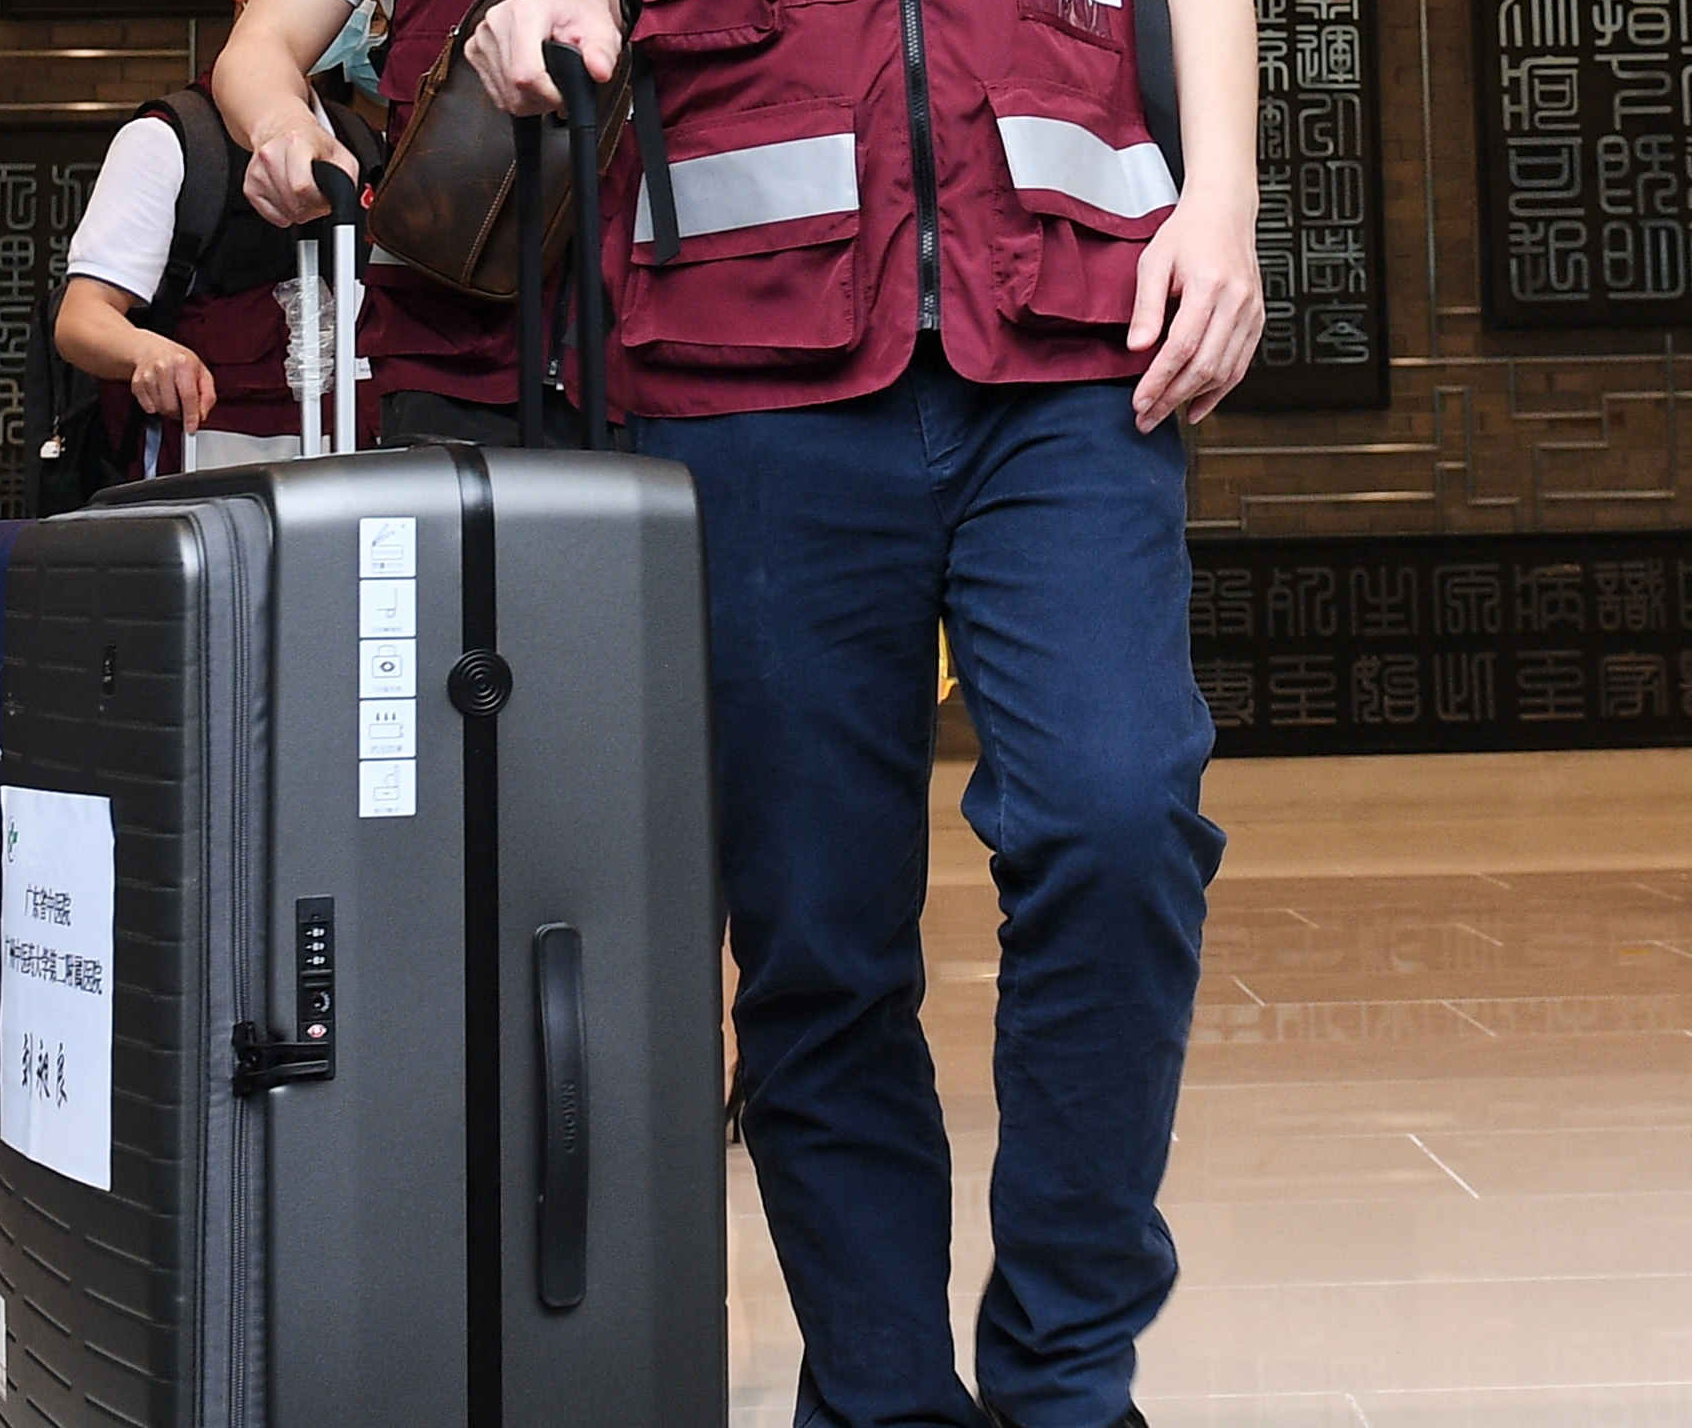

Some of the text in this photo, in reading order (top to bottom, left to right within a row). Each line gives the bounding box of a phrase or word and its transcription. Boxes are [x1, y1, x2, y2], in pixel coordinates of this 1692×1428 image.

[24, 884, 72, 926] 广东省中医院
[4, 935, 103, 996] 广州中医药大学第二附属医院
